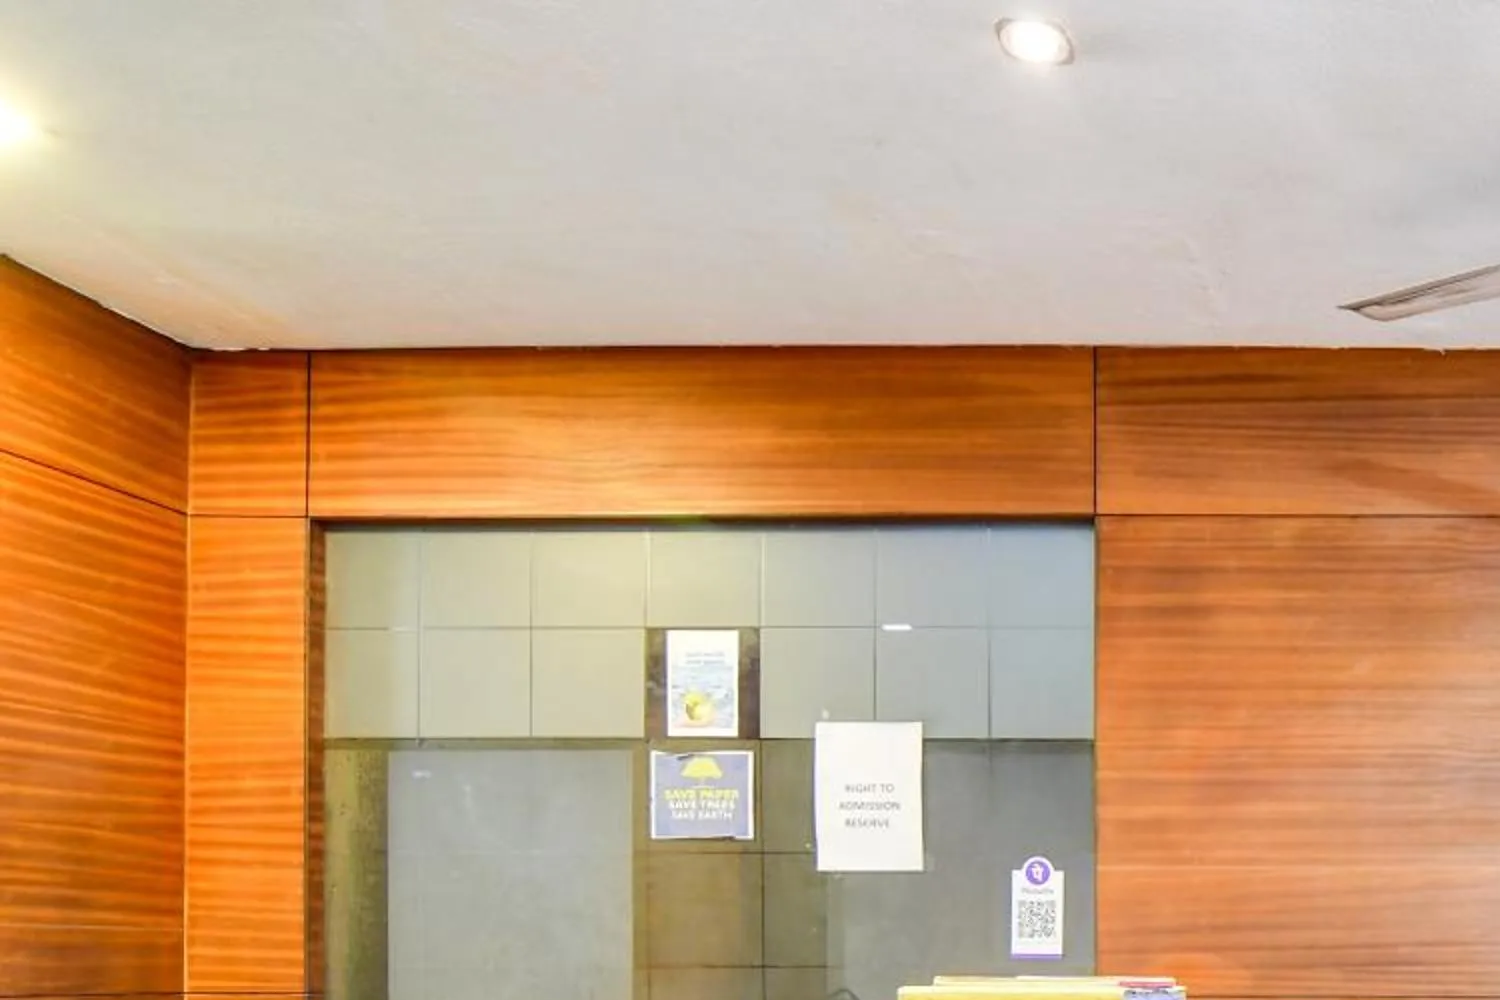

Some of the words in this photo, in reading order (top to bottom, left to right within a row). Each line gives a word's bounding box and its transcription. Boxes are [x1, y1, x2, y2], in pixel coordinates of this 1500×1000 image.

[845, 783, 876, 793] RIGHT
[880, 783, 895, 793] TO
[664, 789, 697, 800] SAVE
[700, 789, 739, 800] PAPER
[669, 800, 697, 809] SAVE
[839, 801, 900, 811] ADMISSION
[845, 818, 889, 828] RESERVE
